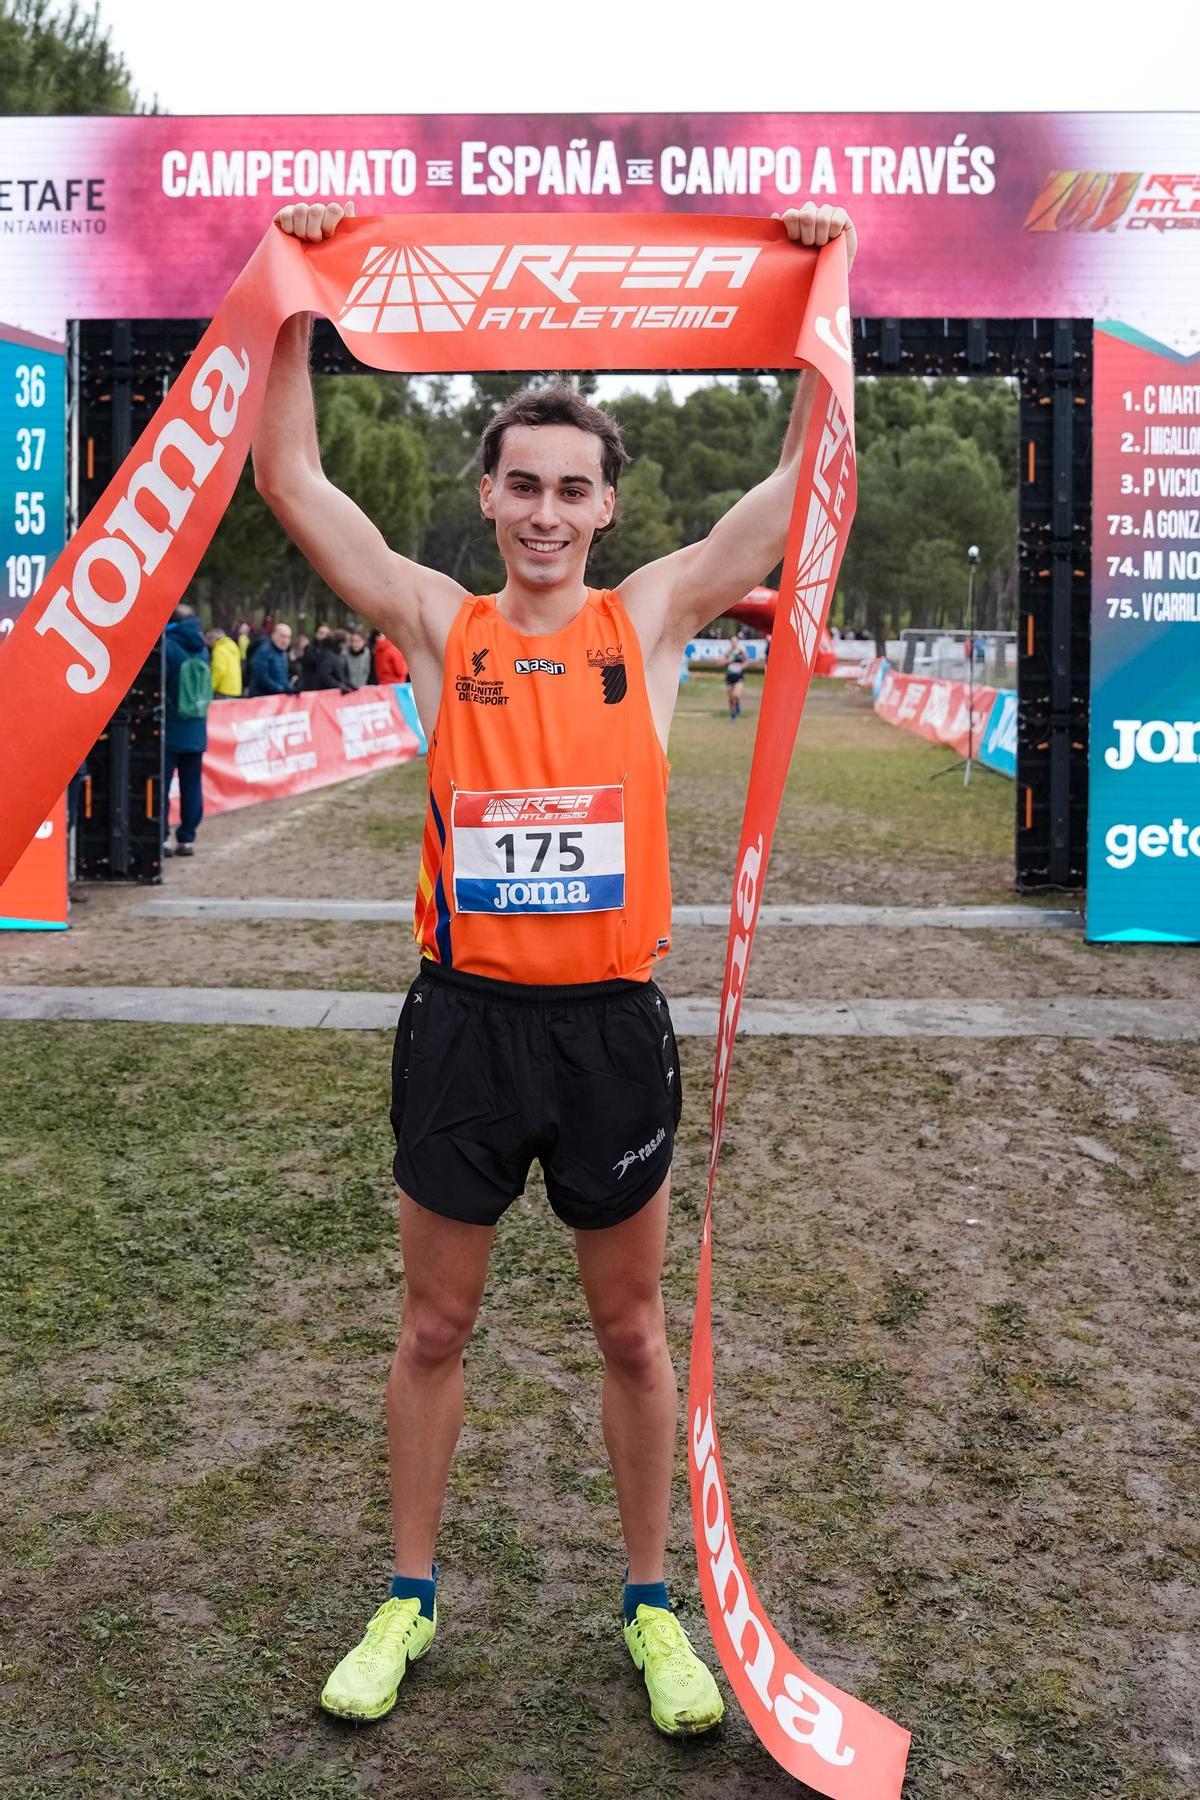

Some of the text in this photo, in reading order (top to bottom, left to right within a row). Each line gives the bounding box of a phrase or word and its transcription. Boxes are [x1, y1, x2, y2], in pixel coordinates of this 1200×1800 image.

[161, 149, 417, 198] CAMPEONATO
[461, 138, 622, 196] ESPAÑA
[660, 145, 801, 196] CAMPO
[810, 146, 837, 194] A
[844, 133, 996, 195] TRAVÉS
[0, 179, 105, 211] ETAFE
[492, 245, 762, 303] RFEA
[478, 305, 739, 330] ATLETISMO
[15, 364, 46, 408] 36
[1122, 391, 1141, 412] 1.
[1144, 385, 1156, 415] C
[16, 428, 46, 471] 37
[1120, 432, 1141, 453] 2.
[1143, 426, 1150, 456] J
[1120, 467, 1200, 498] 3. P VICIO
[15, 492, 46, 535] 55
[1106, 515, 1140, 535] 73.
[1142, 509, 1155, 539] A
[6, 555, 46, 598] 197
[1106, 550, 1200, 580] 74. M NO
[1106, 598, 1139, 619] 75.
[1142, 592, 1153, 622] V
[520, 811, 589, 821] ATLETISMO
[523, 794, 594, 814] RFEA
[495, 831, 585, 874] 175
[493, 880, 590, 909] Joma
